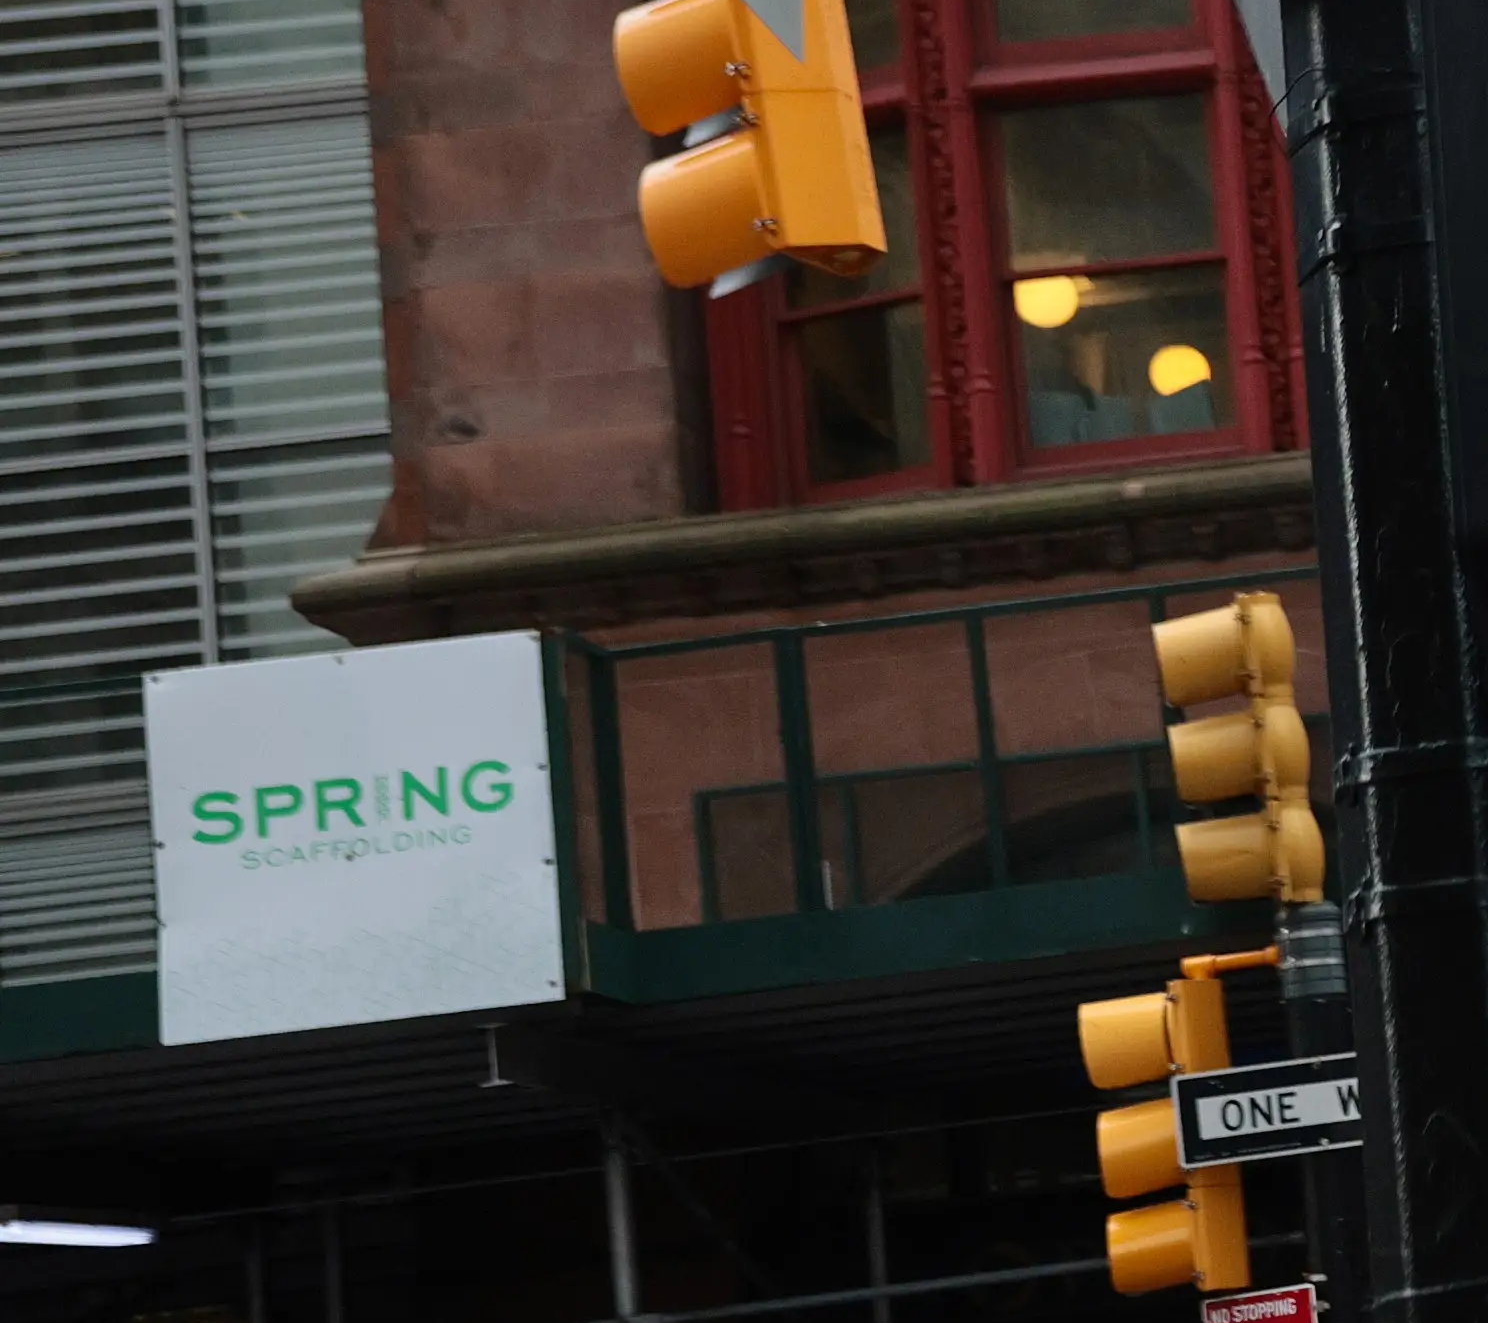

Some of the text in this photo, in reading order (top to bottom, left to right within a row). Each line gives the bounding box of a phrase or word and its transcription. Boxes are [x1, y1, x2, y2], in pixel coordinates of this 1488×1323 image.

[191, 759, 515, 846] SPRING
[239, 824, 474, 871] SCAFFOLDING
[1222, 1091, 1301, 1132] ONE
[1231, 1296, 1297, 1323] STOPPING
